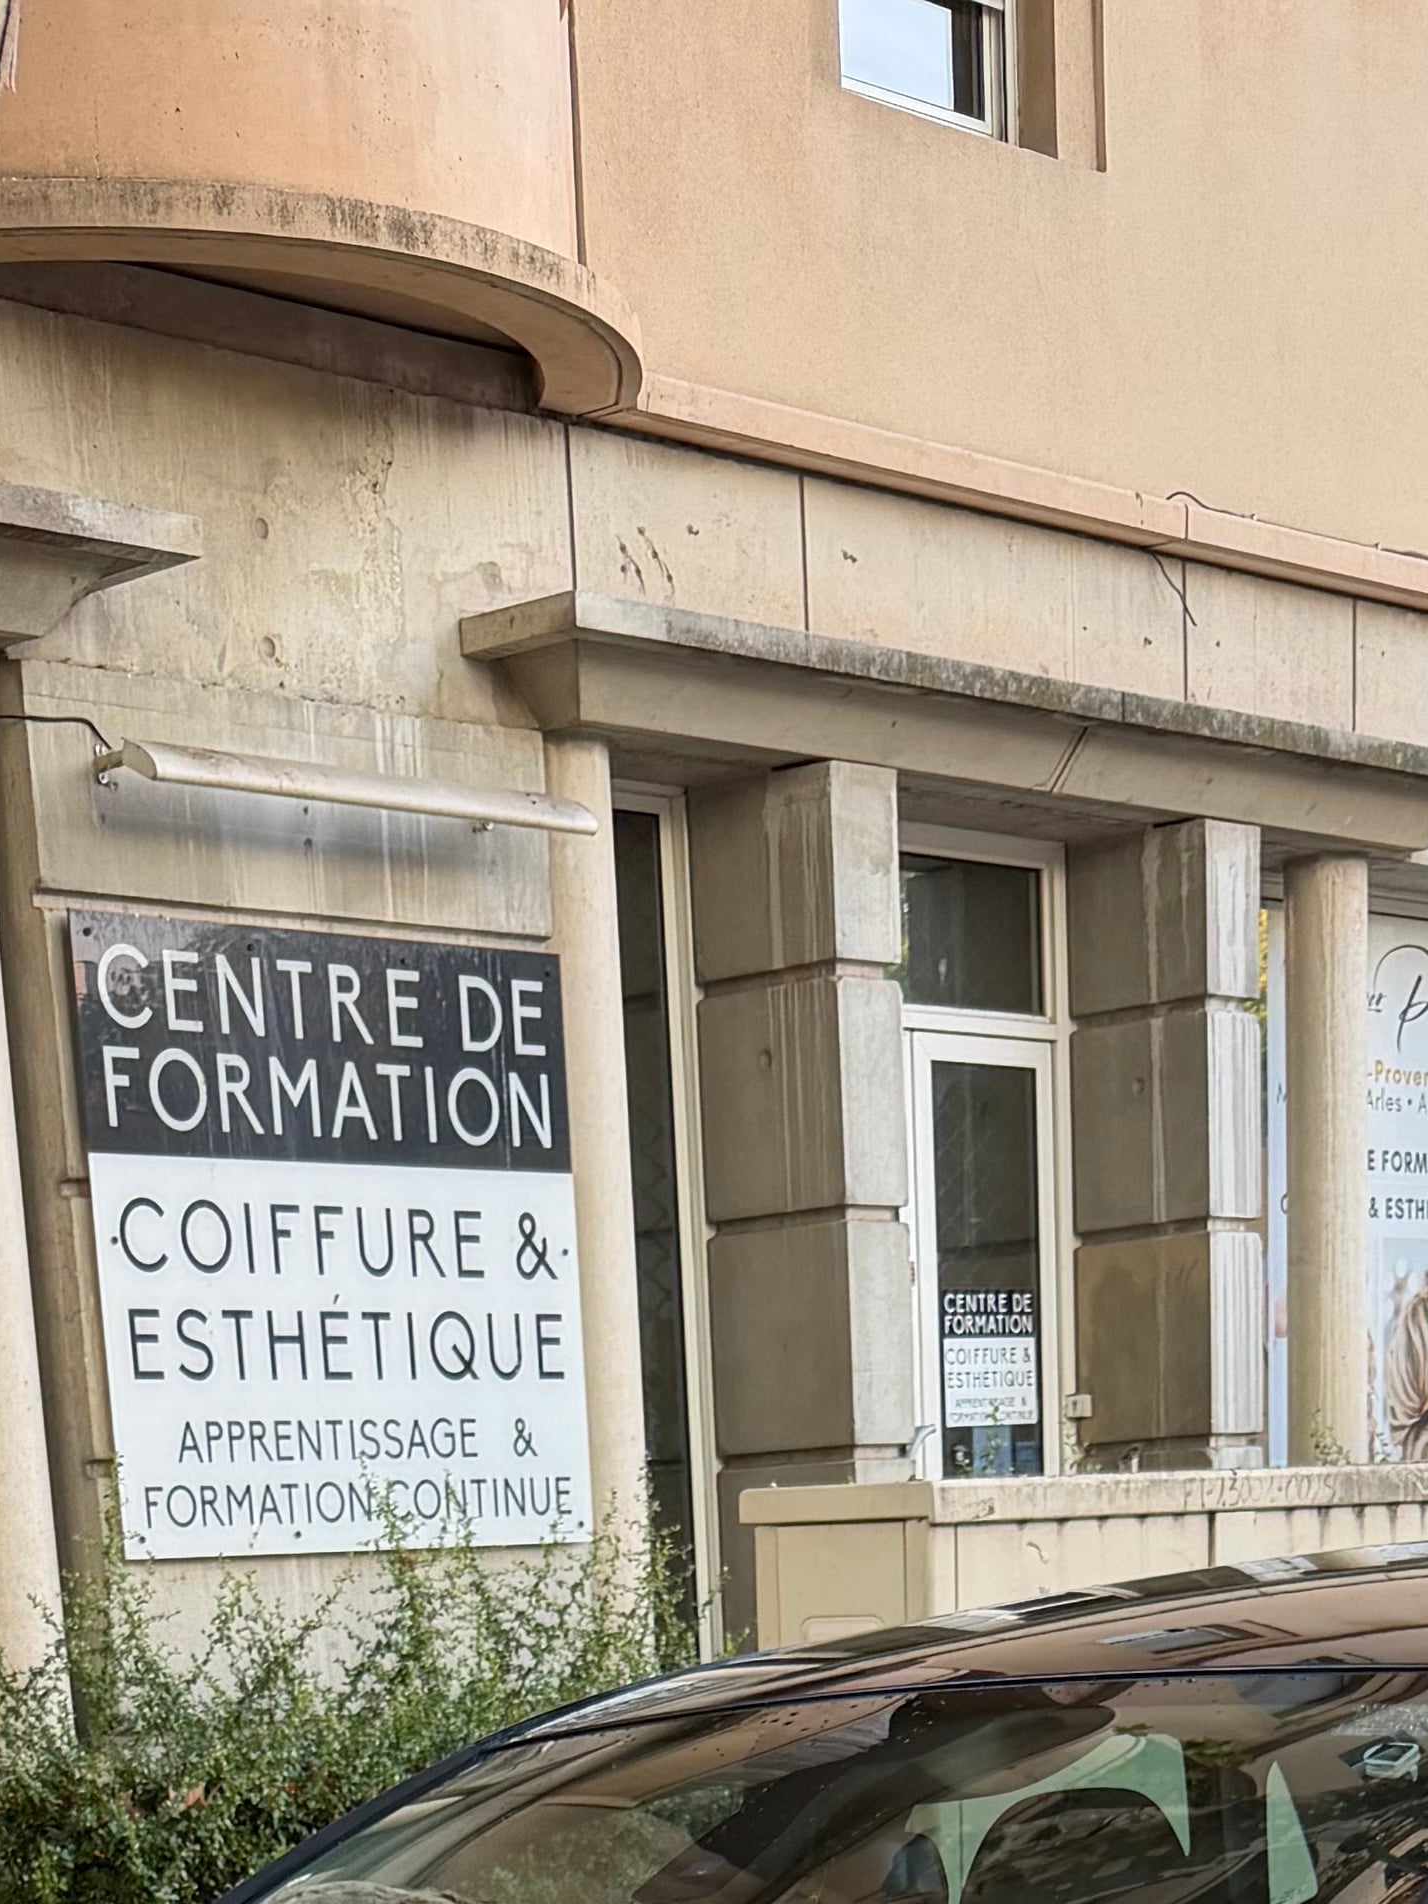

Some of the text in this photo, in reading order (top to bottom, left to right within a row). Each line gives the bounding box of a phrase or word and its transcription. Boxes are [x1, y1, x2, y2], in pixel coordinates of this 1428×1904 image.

[97, 942, 548, 1056] CENTRE DE
[101, 1045, 555, 1150] FORMATION
[1368, 1196, 1380, 1219] &
[117, 1196, 559, 1280] COIFFURE &
[943, 1292, 1033, 1314] CENTRE DE
[943, 1314, 1034, 1335] FORMATION
[127, 1293, 566, 1382] ESTHÉTIQUE
[946, 1346, 1018, 1367] COIFFURE
[946, 1368, 1035, 1390] ESTHÉTIQUE
[178, 1417, 539, 1464] APPRENTISSAGE &
[144, 1475, 573, 1530] FORMATION CONTINUE
